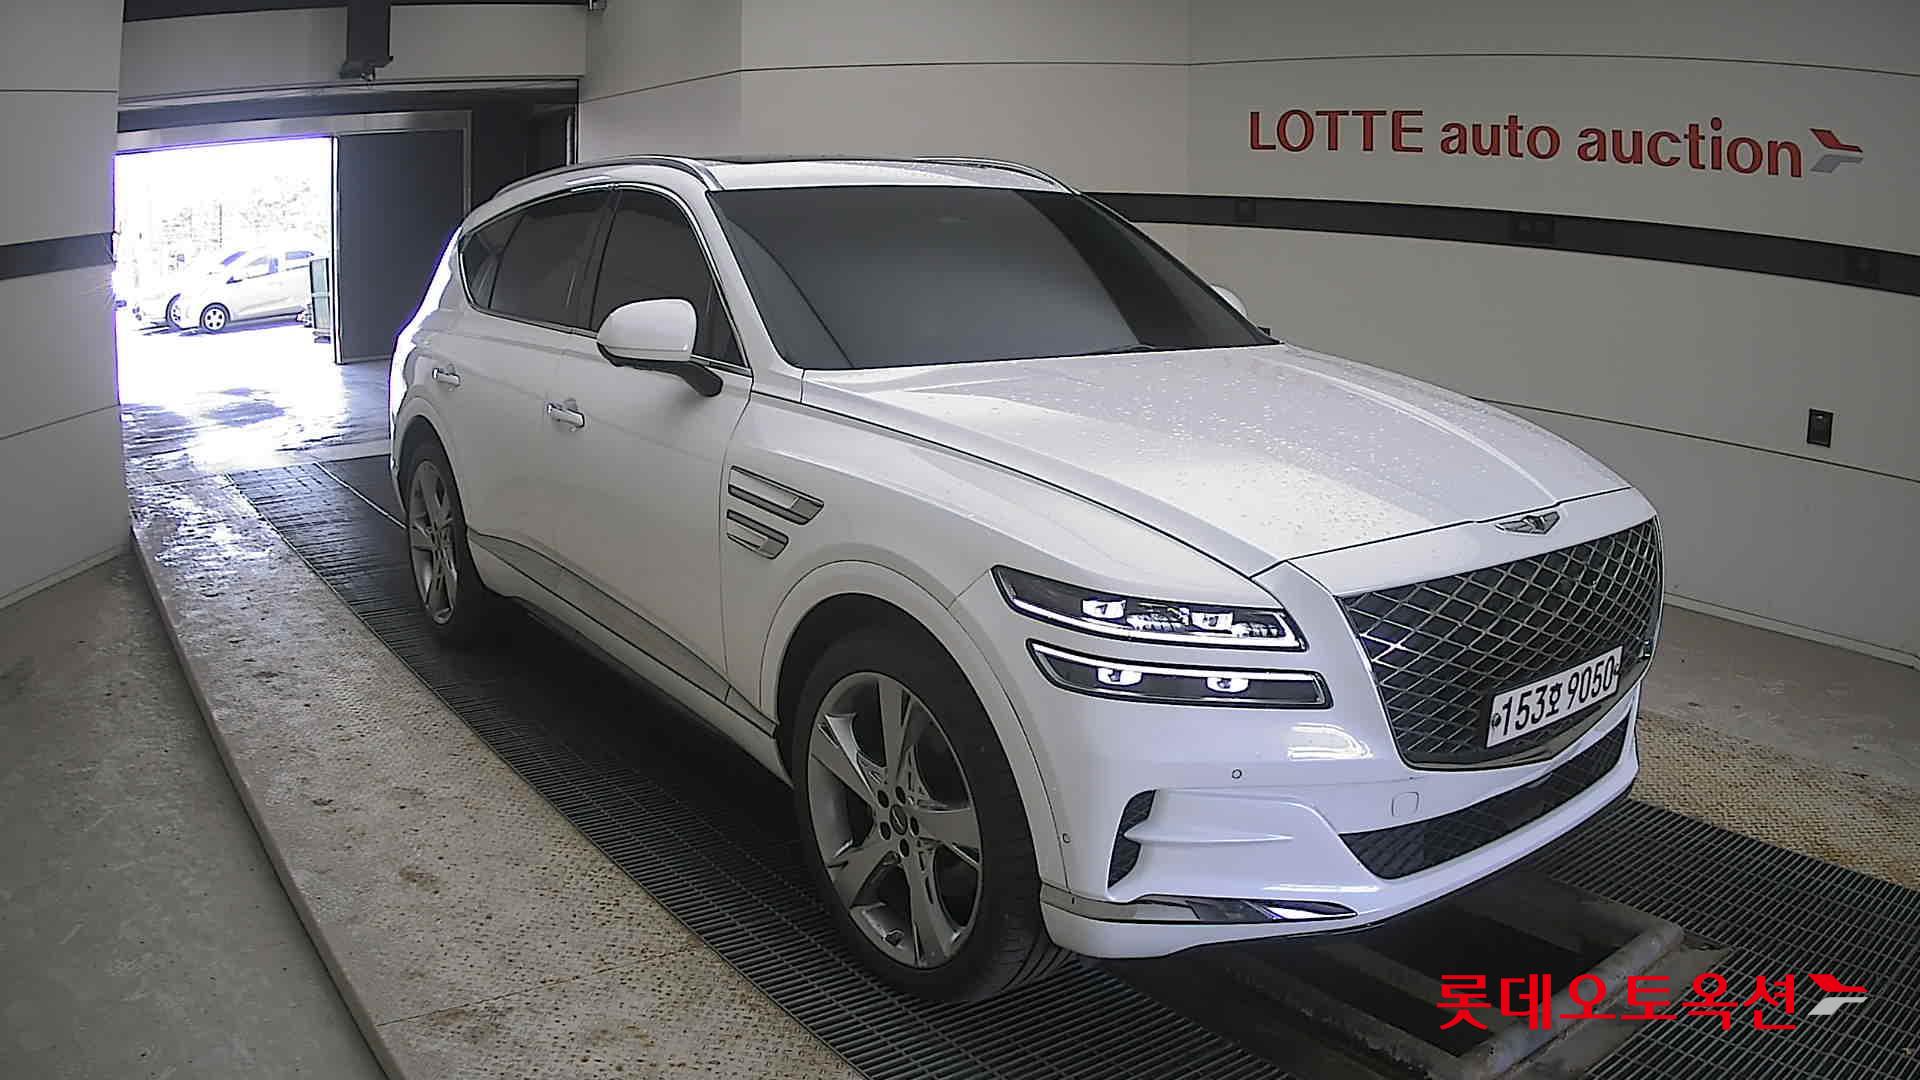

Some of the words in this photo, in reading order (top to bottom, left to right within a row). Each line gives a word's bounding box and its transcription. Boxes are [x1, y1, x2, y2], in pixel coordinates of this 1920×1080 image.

[1249, 109, 1424, 153] LOTTE
[1440, 115, 1560, 160] auto
[1577, 117, 1803, 178] auction
[1502, 681, 1563, 736] 153호
[1567, 655, 1616, 710] 9050
